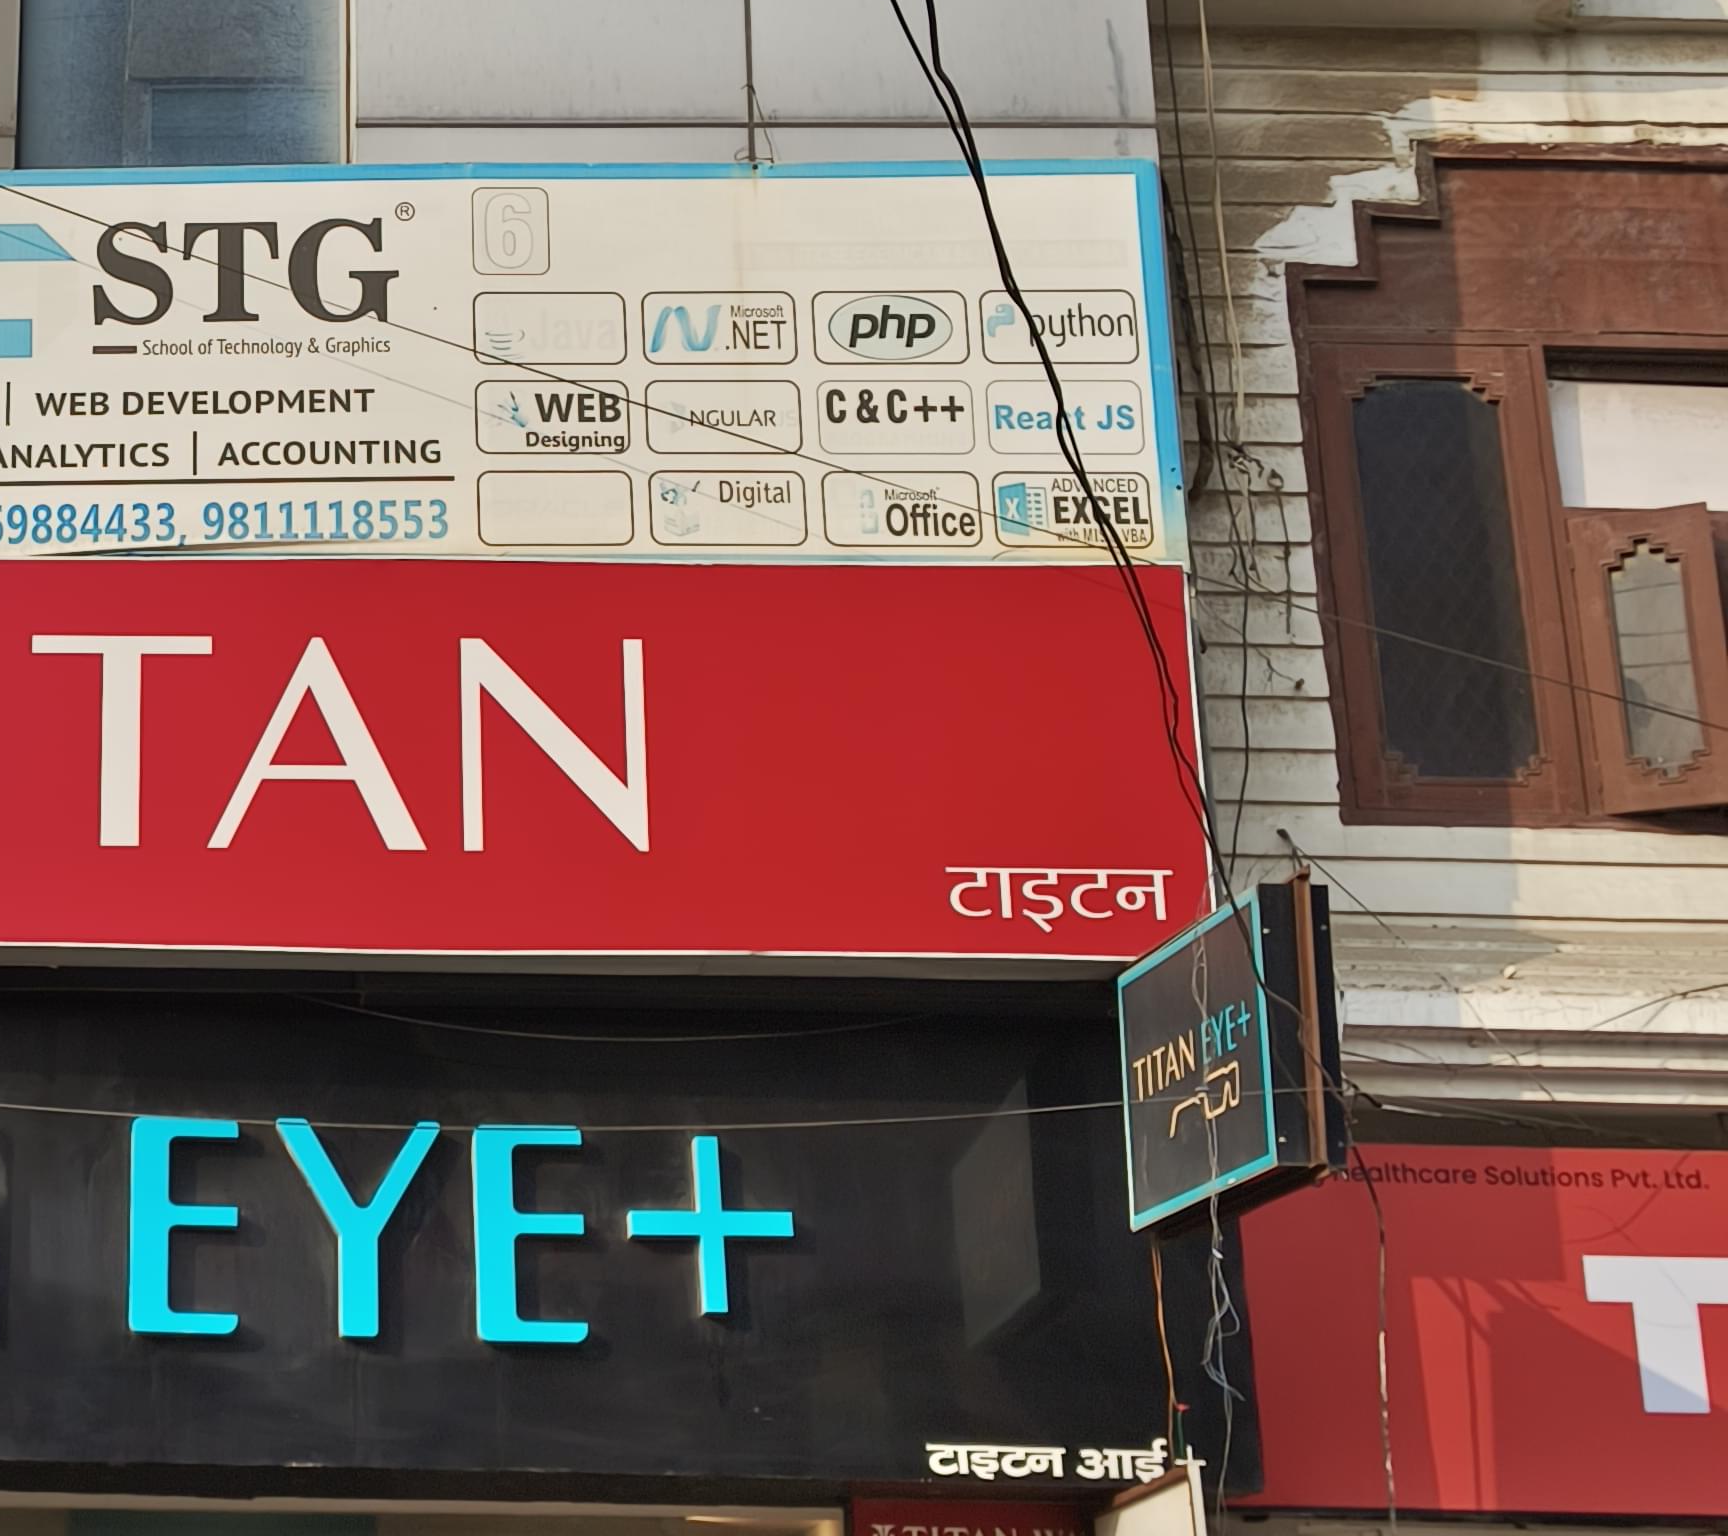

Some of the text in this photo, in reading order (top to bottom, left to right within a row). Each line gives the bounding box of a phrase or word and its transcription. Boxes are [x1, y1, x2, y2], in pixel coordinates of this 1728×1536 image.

[93, 216, 400, 327] STG
[730, 305, 784, 319] Microsoft
[849, 305, 937, 348] php
[143, 335, 391, 359] School of Technology & Graphics
[725, 320, 788, 351] .NET
[35, 391, 110, 417] WEB
[122, 387, 376, 416] DEVELOPMENT
[534, 392, 623, 423] WEB
[826, 389, 847, 424] C
[856, 389, 881, 424] &
[994, 404, 1135, 431] Reat JS
[218, 438, 443, 467] ACCOUNTING
[525, 431, 626, 452] Designing
[719, 480, 792, 508] Digital
[884, 488, 937, 501] Microsoft
[202, 497, 450, 544] 9811118553
[885, 503, 976, 537] Office
[944, 866, 1174, 933] टाइटन
[1132, 1000, 1252, 1103] TITAN EYE+
[1485, 1165, 1604, 1187] Solutions
[1612, 1168, 1658, 1190] Pvt.
[1664, 1170, 1710, 1190] Ltd.
[127, 1116, 795, 1344] EYE+
[925, 1442, 1066, 1481] टाइटन
